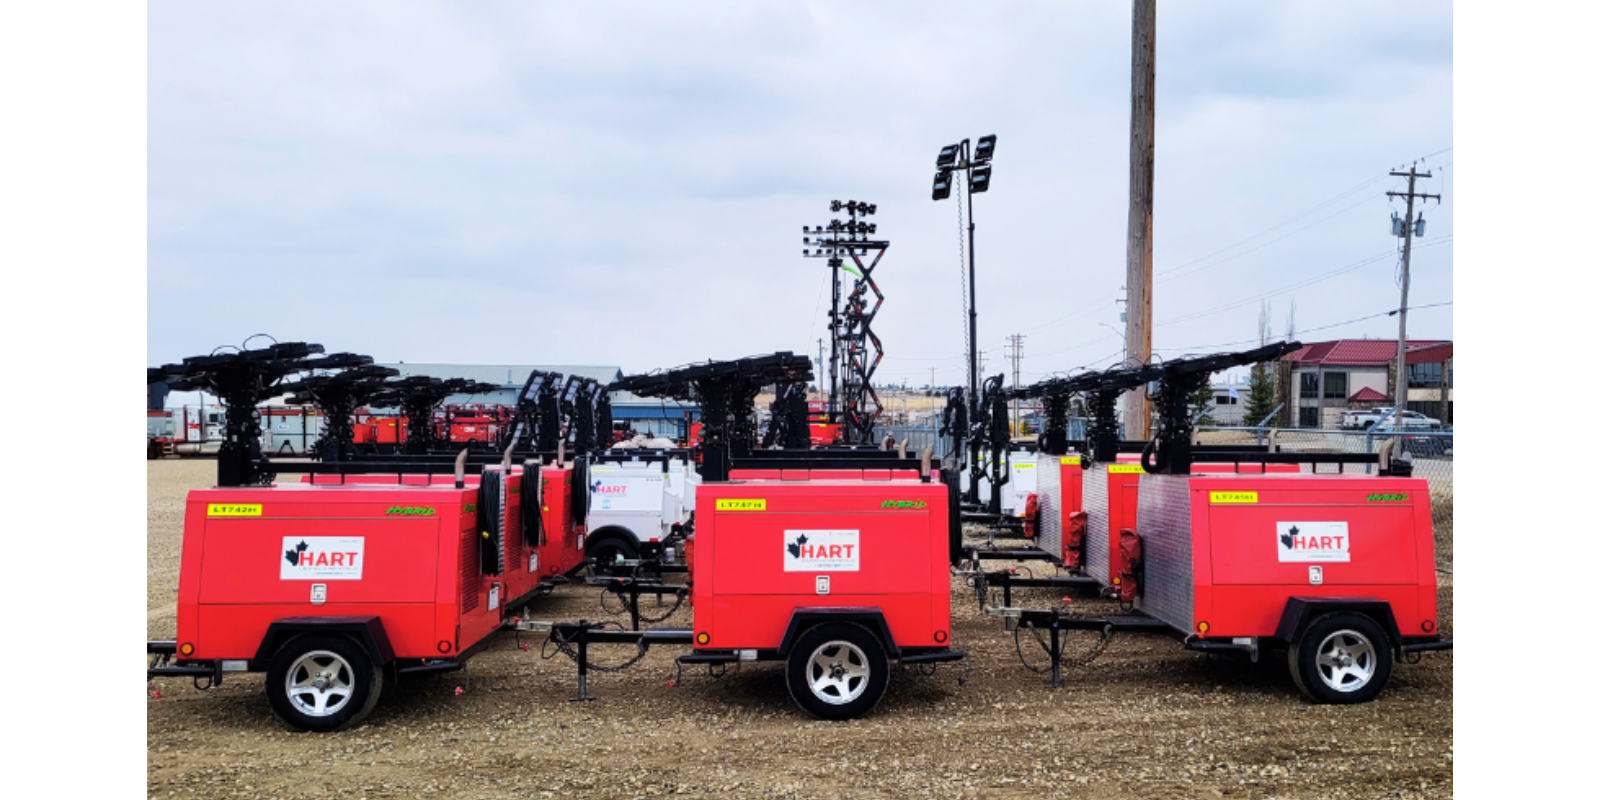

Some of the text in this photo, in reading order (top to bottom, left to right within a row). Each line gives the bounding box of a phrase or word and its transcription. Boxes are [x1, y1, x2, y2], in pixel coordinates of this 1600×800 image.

[597, 485, 628, 494] HART
[1293, 535, 1345, 550] HART
[299, 551, 359, 567] HART
[801, 544, 855, 559] HART
